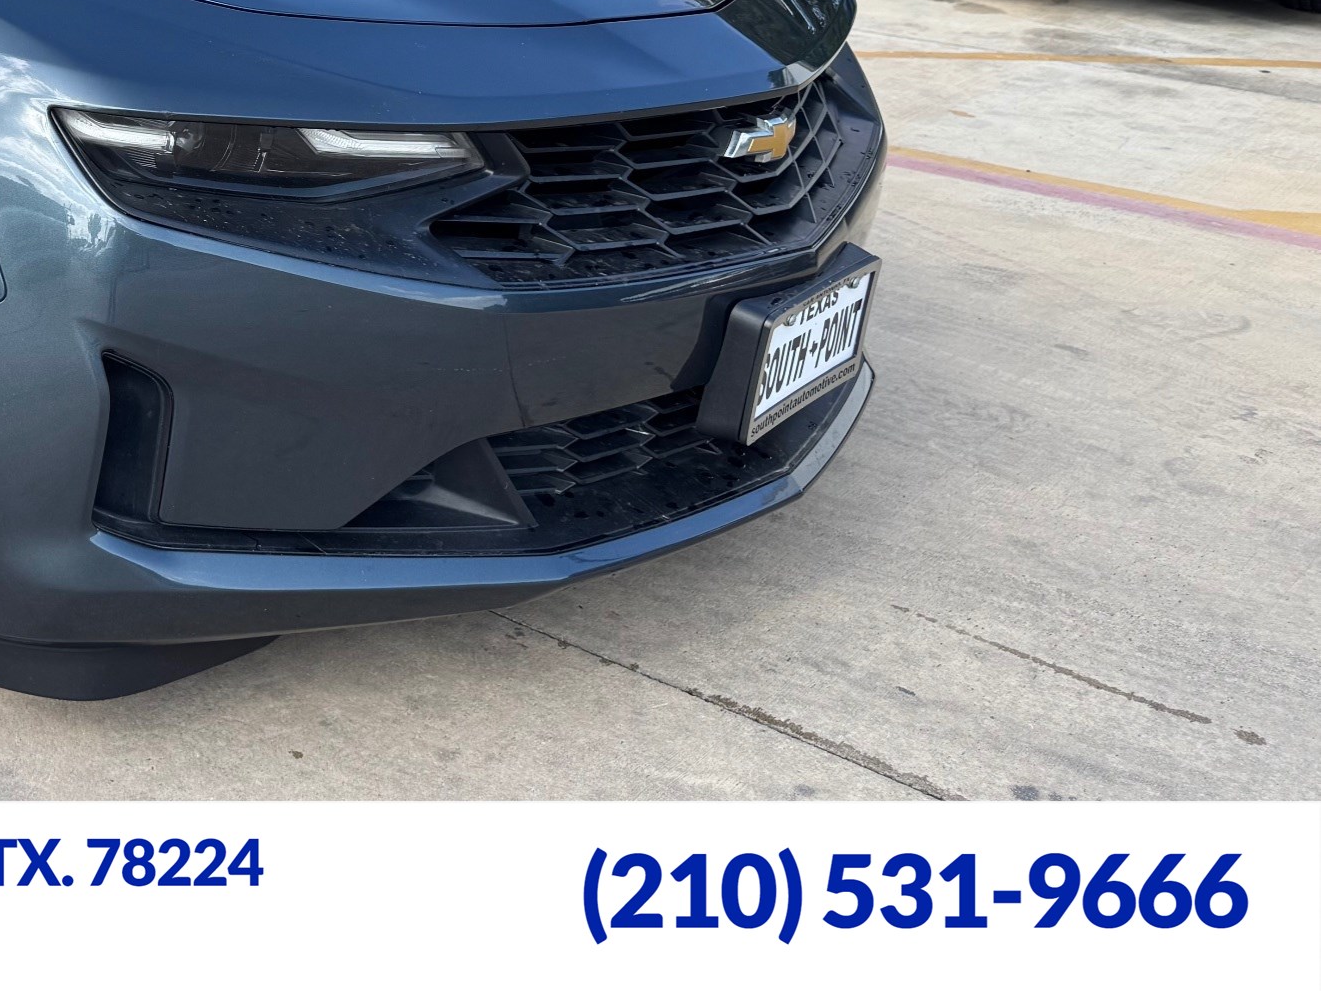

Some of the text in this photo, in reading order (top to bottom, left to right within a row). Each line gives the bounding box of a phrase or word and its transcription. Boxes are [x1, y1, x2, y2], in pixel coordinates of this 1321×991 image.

[799, 291, 840, 326] TEXAS
[756, 298, 863, 406] SOUTH POINT
[750, 363, 856, 438] southpointautomotive.com
